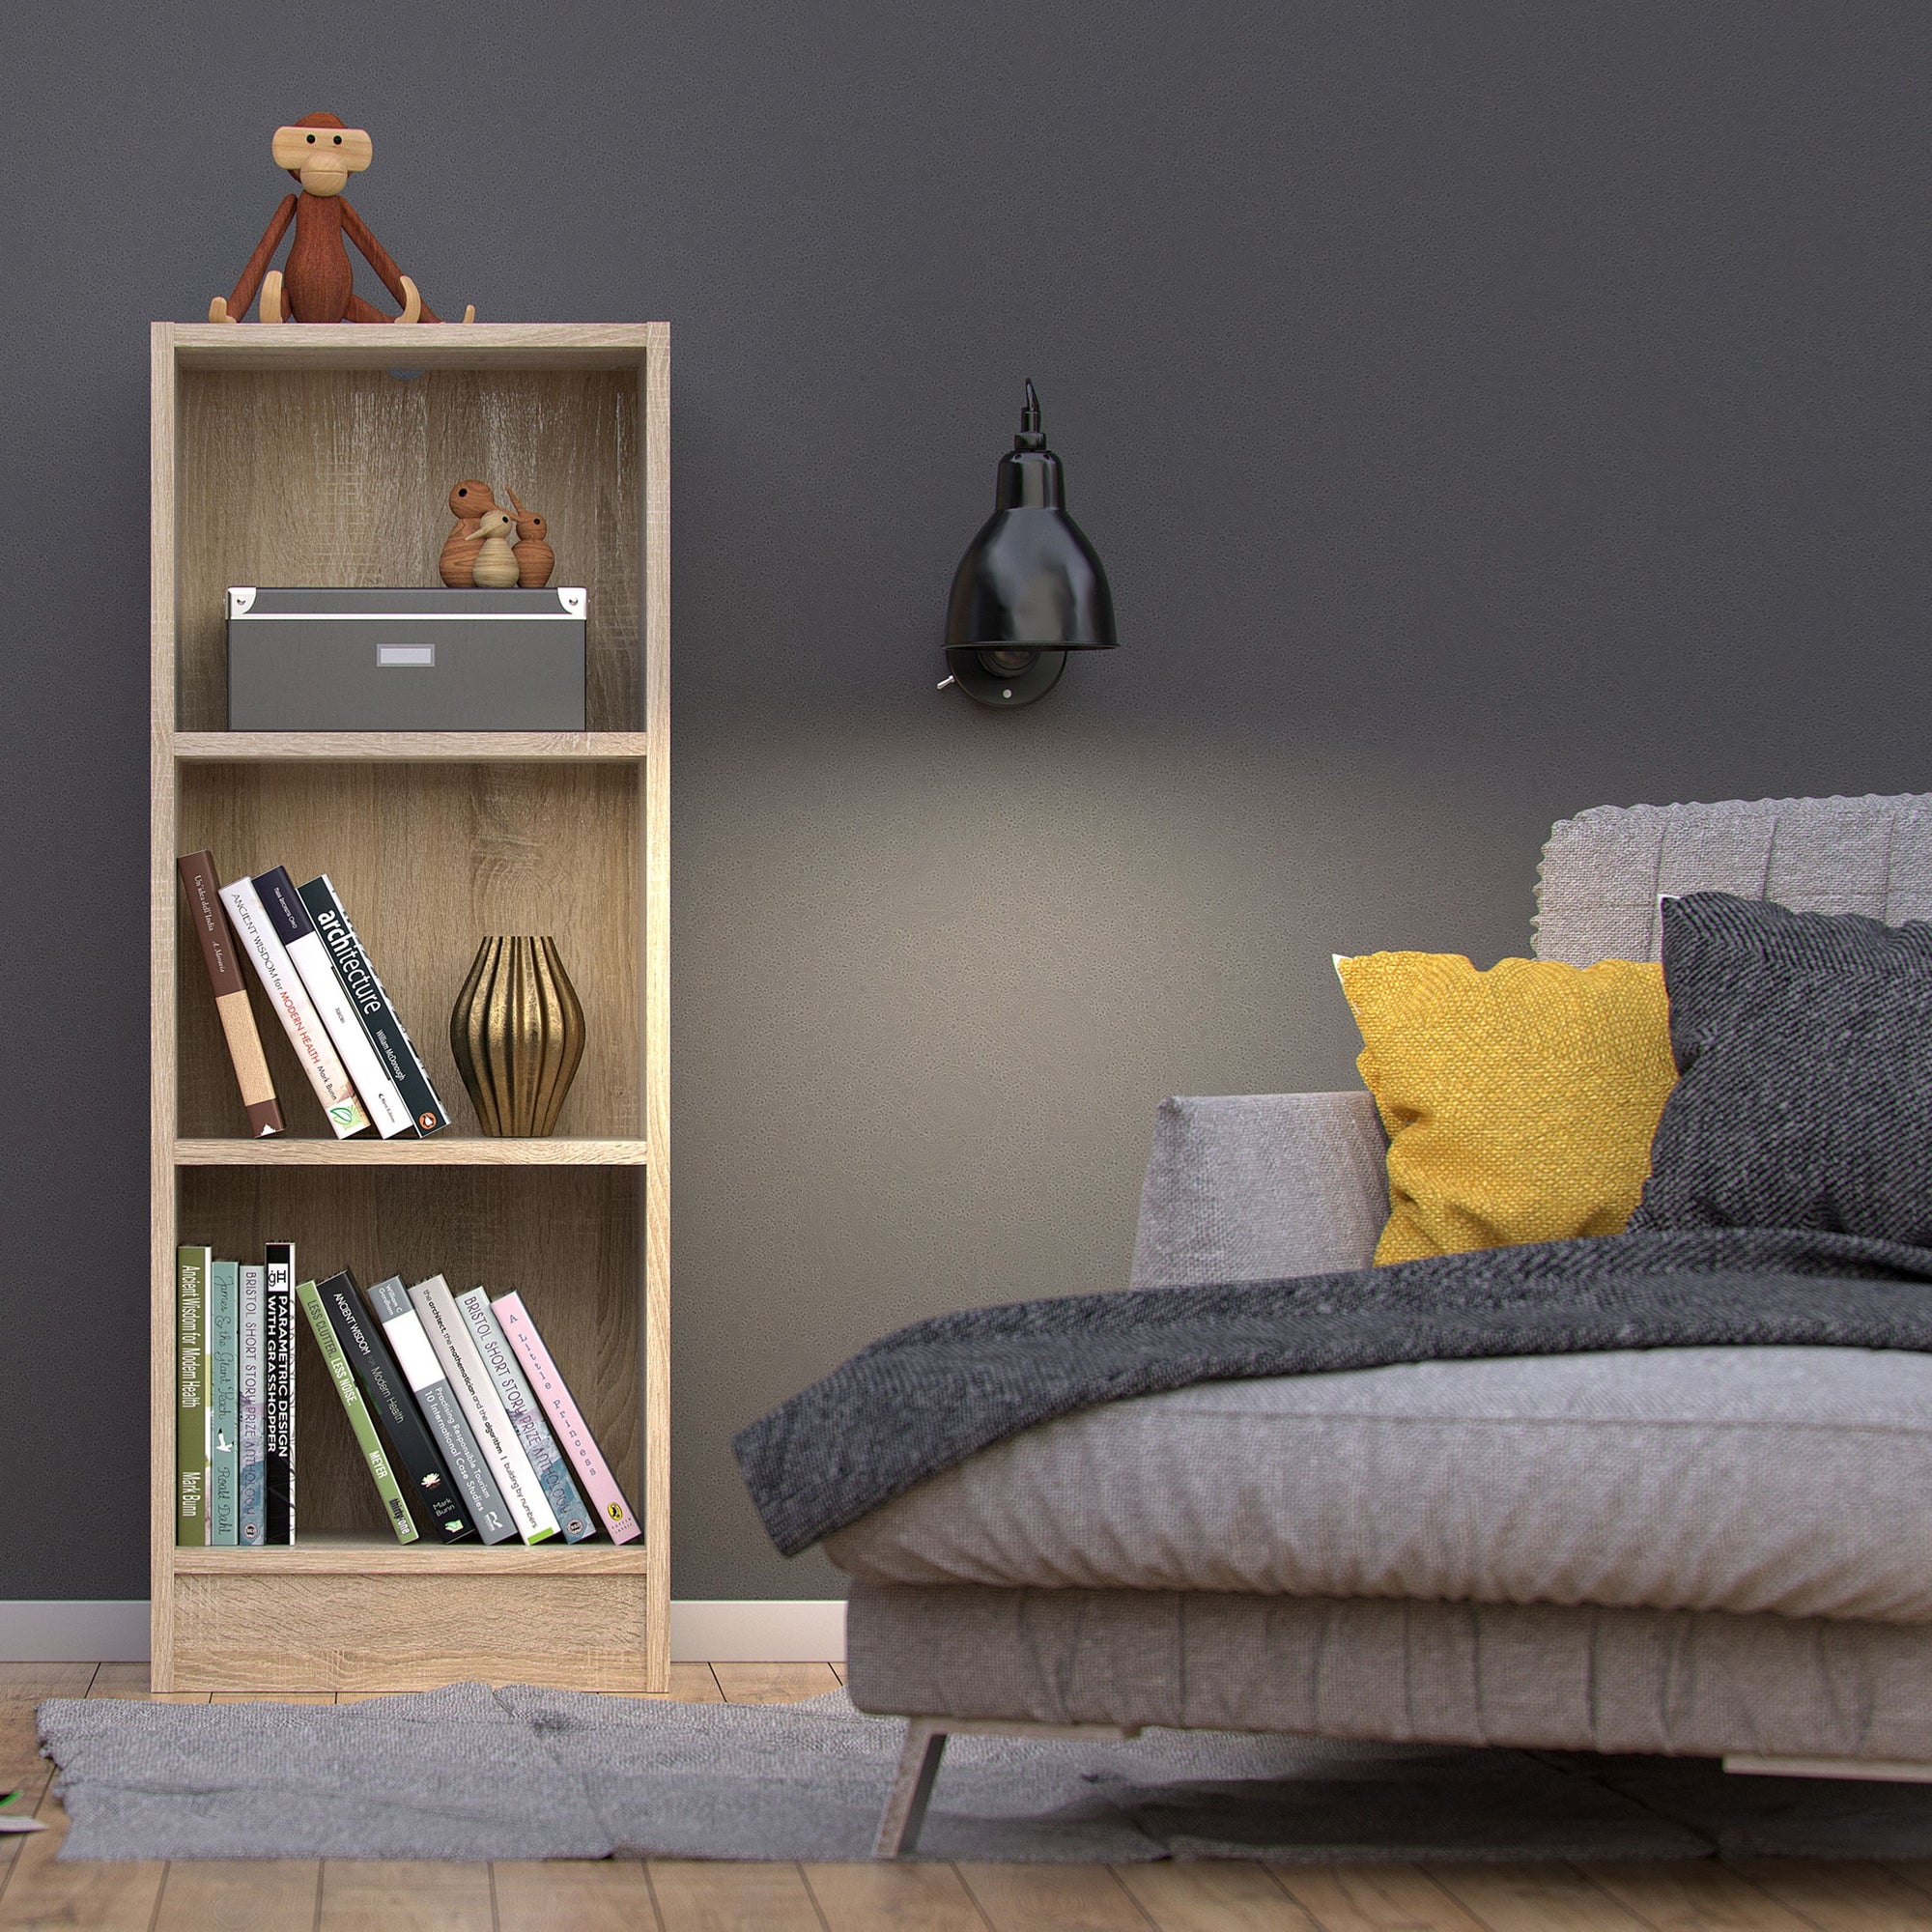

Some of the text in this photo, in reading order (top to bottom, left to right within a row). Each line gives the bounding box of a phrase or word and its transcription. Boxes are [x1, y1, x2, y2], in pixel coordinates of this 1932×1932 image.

[231, 895, 321, 1064] ANCIENT WISDOM for MODERN HEALTH
[318, 909, 381, 1015] architecture
[376, 1029, 389, 1050] William
[385, 1048, 406, 1081] McDonough
[317, 1065, 337, 1100] Mark Bunn
[213, 1274, 235, 1313] James
[245, 1272, 257, 1318] BRISTOL
[386, 1284, 398, 1307] William
[182, 1265, 201, 1407] Ancient Wisdom for Modern Health
[219, 1330, 231, 1348] the
[245, 1322, 257, 1360] SHORT
[307, 1299, 357, 1406] LESS CLUTTER. LESS NOISE.
[333, 1293, 356, 1324] ANCIENT
[350, 1322, 371, 1355] WISDOM
[371, 1366, 391, 1398] Modern
[386, 1397, 404, 1424] Health
[213, 1350, 234, 1384] Giant
[242, 1364, 257, 1403] STORY
[267, 1295, 276, 1452] WITH GRASSHOPPER
[278, 1295, 288, 1457] PARAMETRIC DESIGN
[464, 1296, 492, 1341] BRISTOL
[484, 1341, 511, 1377] SHORT
[499, 1377, 527, 1416] STORY
[519, 1414, 541, 1446] PRIZE
[217, 1385, 236, 1421] Peach
[244, 1406, 257, 1436] PRIZE
[423, 1289, 432, 1302] the
[443, 1333, 452, 1345] the
[449, 1345, 475, 1396] mathematician
[472, 1395, 483, 1409] and
[479, 1409, 488, 1421] the
[484, 1421, 502, 1454] algorithm
[503, 1463, 520, 1490] building
[516, 1488, 524, 1497] by
[521, 1497, 537, 1529] numbers
[369, 1450, 388, 1479] MEYER
[425, 1391, 484, 1512] 10 International Case Studies
[435, 1387, 490, 1498] Practising Responsible Tourism
[183, 1472, 201, 1517] Mark Bunn
[217, 1466, 233, 1535] Roald Dahl
[433, 1498, 452, 1510] Mark
[436, 1504, 455, 1517] Bunn
